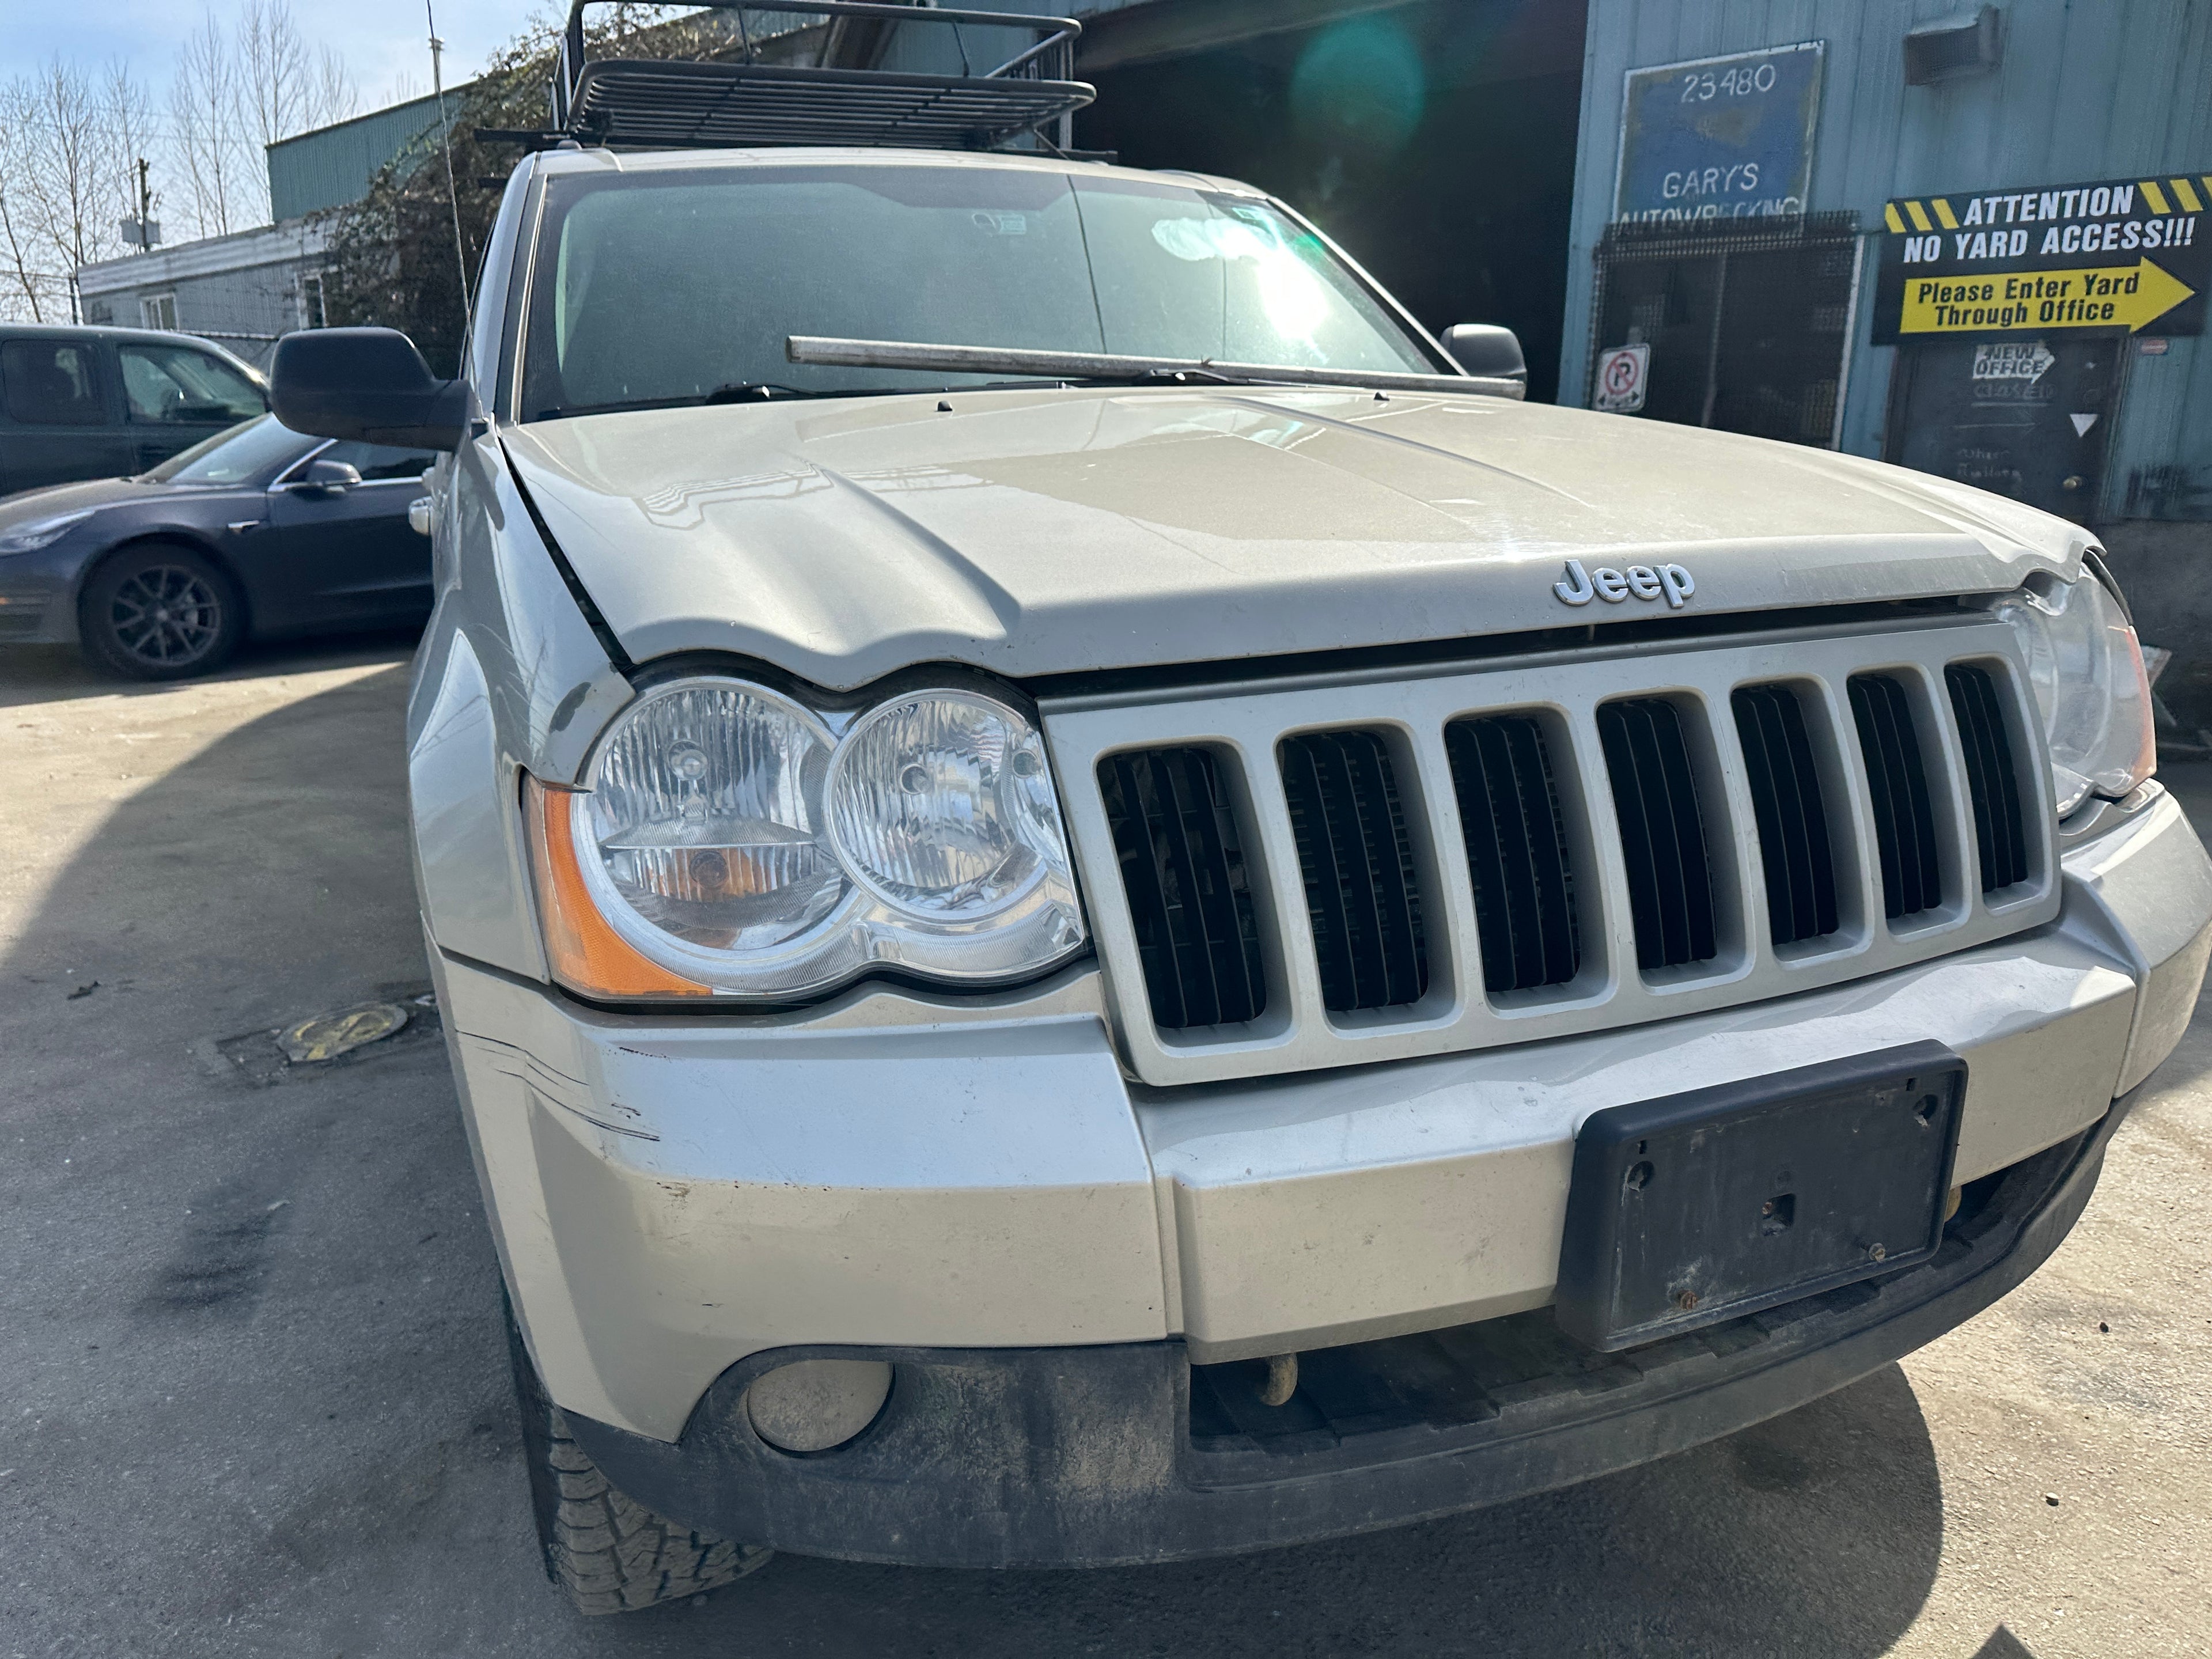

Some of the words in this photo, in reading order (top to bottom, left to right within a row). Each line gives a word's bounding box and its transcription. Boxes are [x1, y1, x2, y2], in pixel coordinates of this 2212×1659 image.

[1681, 63, 1777, 103] 23480
[1663, 162, 1759, 199] GARY'S
[1963, 185, 2134, 226] ATTENTION
[1903, 235, 1941, 263] NO
[1955, 229, 2028, 260] YARD
[2040, 217, 2196, 255] ACCESS!!!
[1918, 282, 1993, 304] Please
[2005, 278, 2070, 299] Enter
[2084, 272, 2140, 296] Yard
[1935, 303, 2028, 327] Through
[2039, 300, 2115, 322] Office
[1976, 358, 2044, 374] OFFICE
[1984, 345, 2036, 359] NEW
[1552, 559, 1695, 609] Jeep
